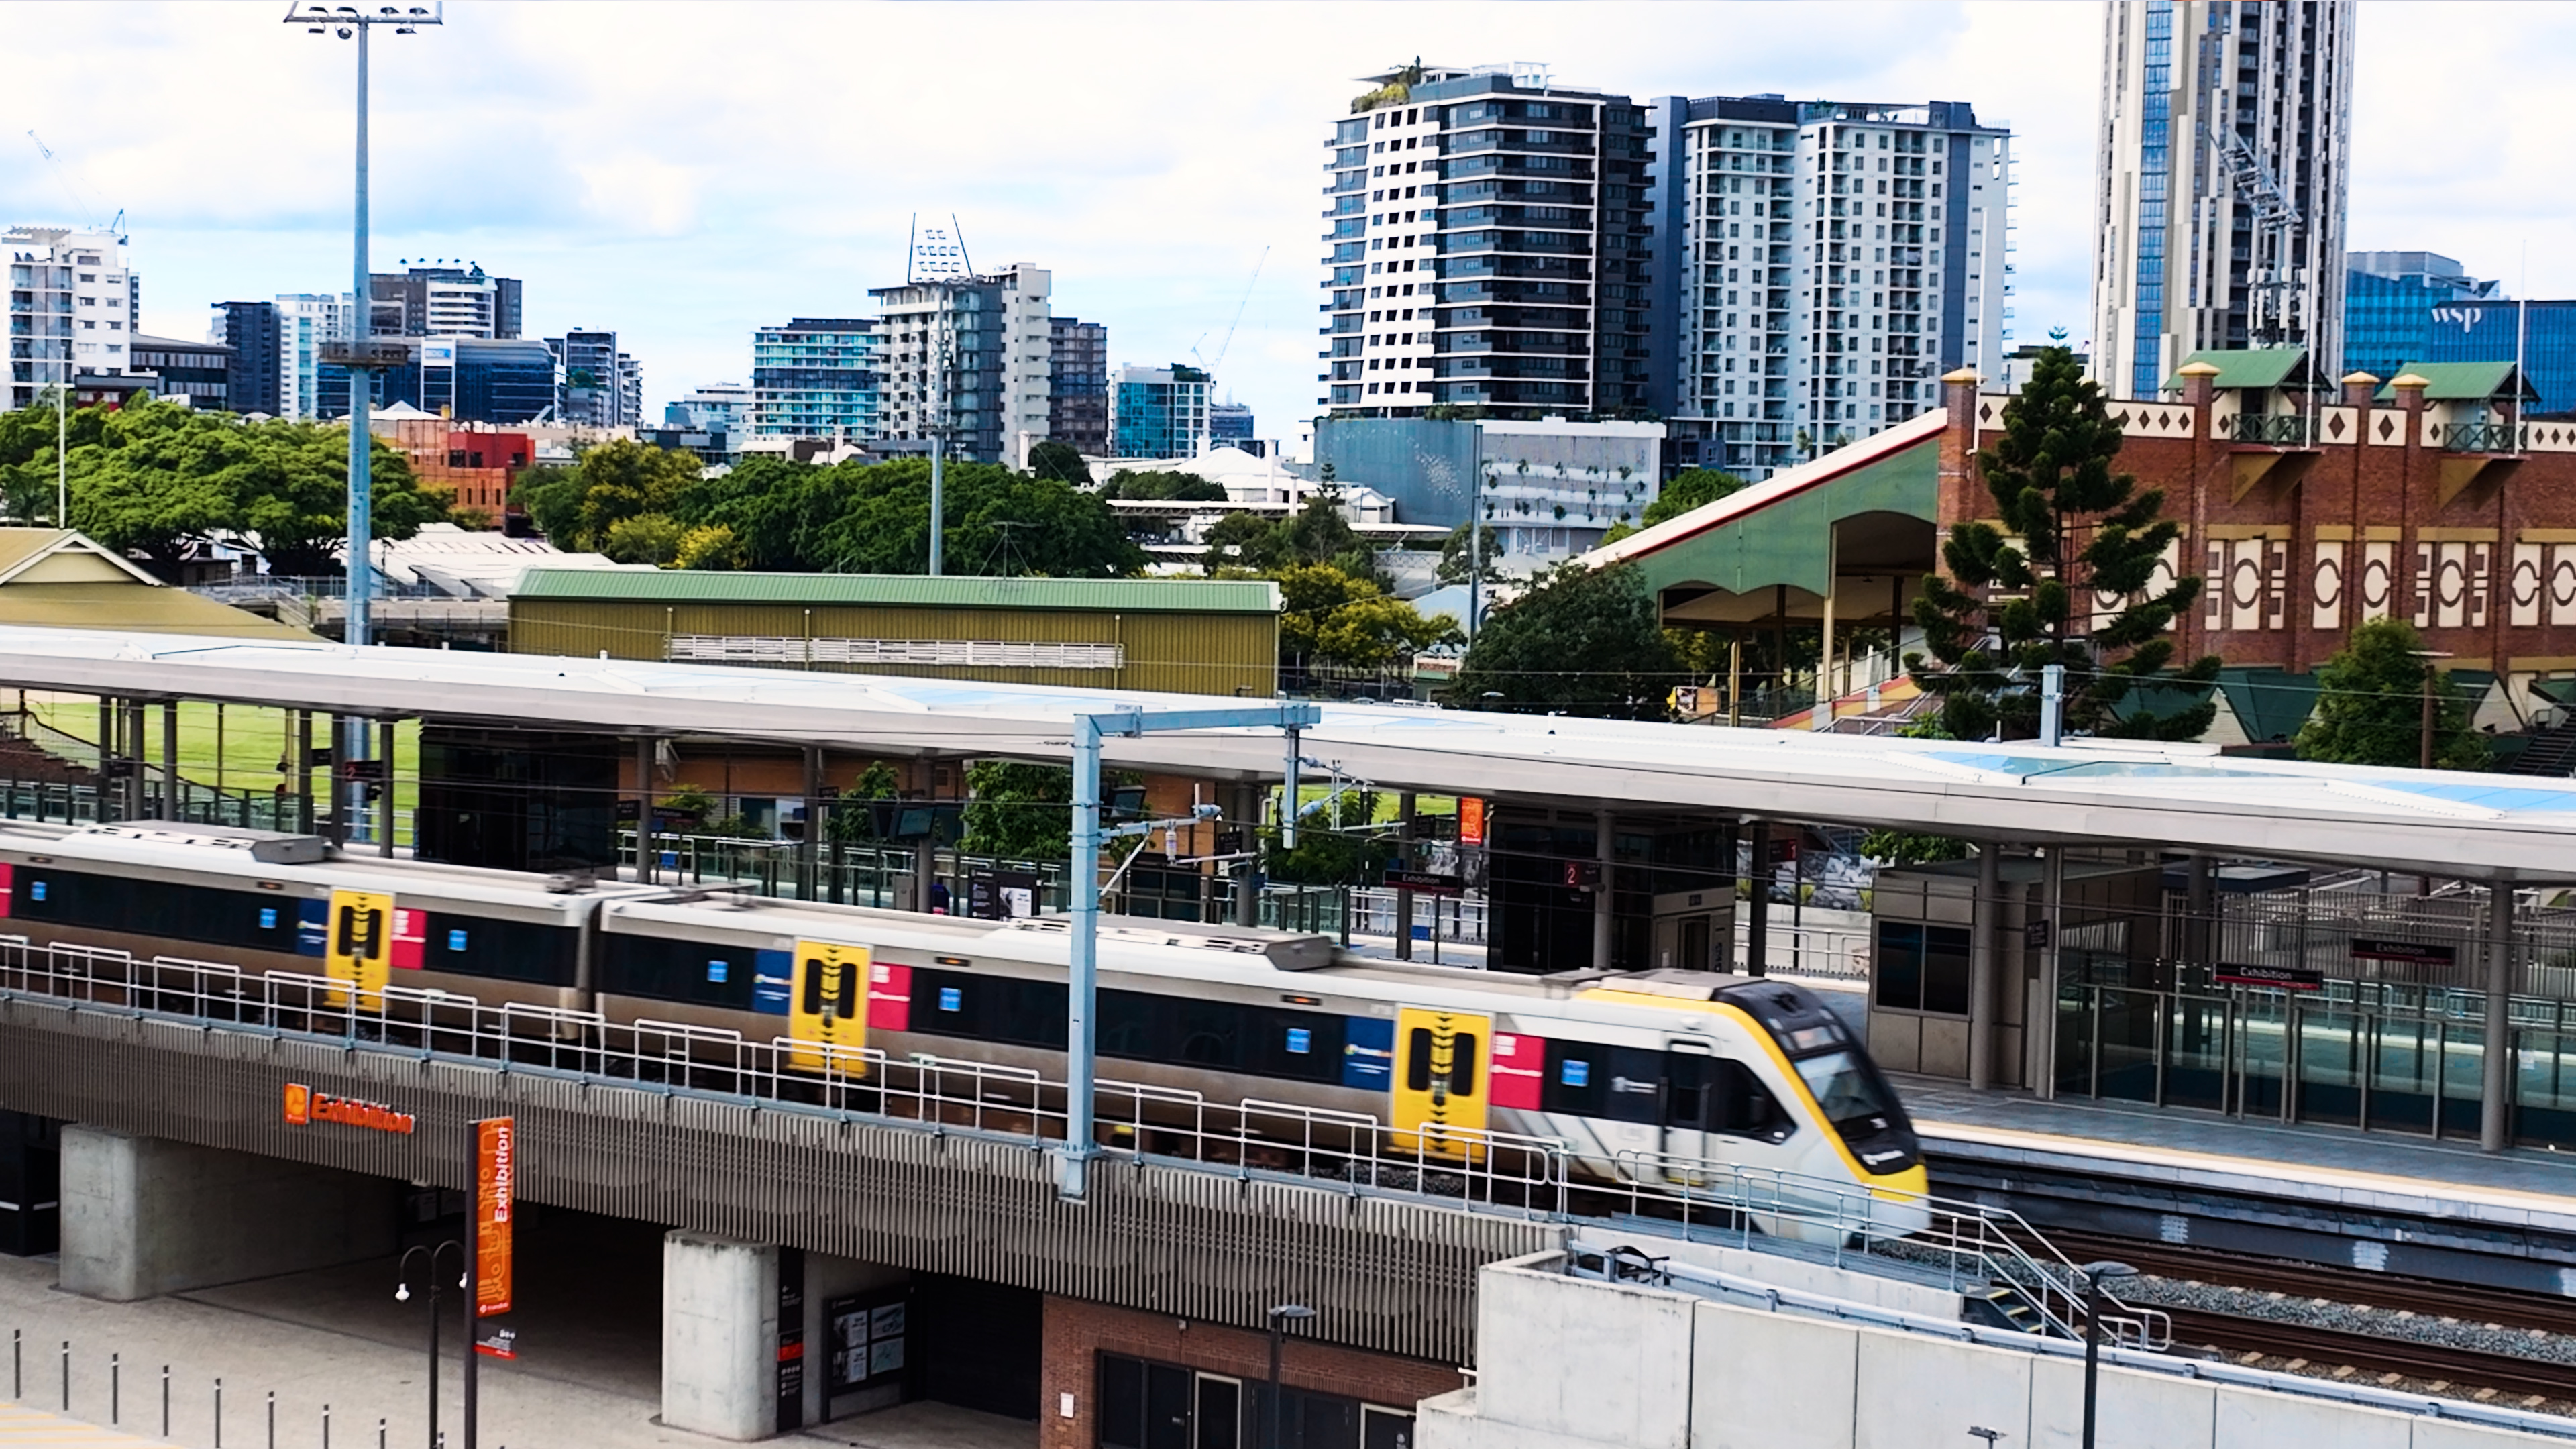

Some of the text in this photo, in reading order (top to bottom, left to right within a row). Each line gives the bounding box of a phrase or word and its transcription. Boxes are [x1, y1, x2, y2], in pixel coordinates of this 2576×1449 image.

[1402, 874, 1440, 885] Exhibition
[1568, 867, 1576, 884] 2
[2375, 943, 2426, 955] Exhibition
[2240, 967, 2292, 980] Exhibition
[310, 1093, 415, 1135] Exhibition
[494, 1127, 510, 1222] Exhibition
